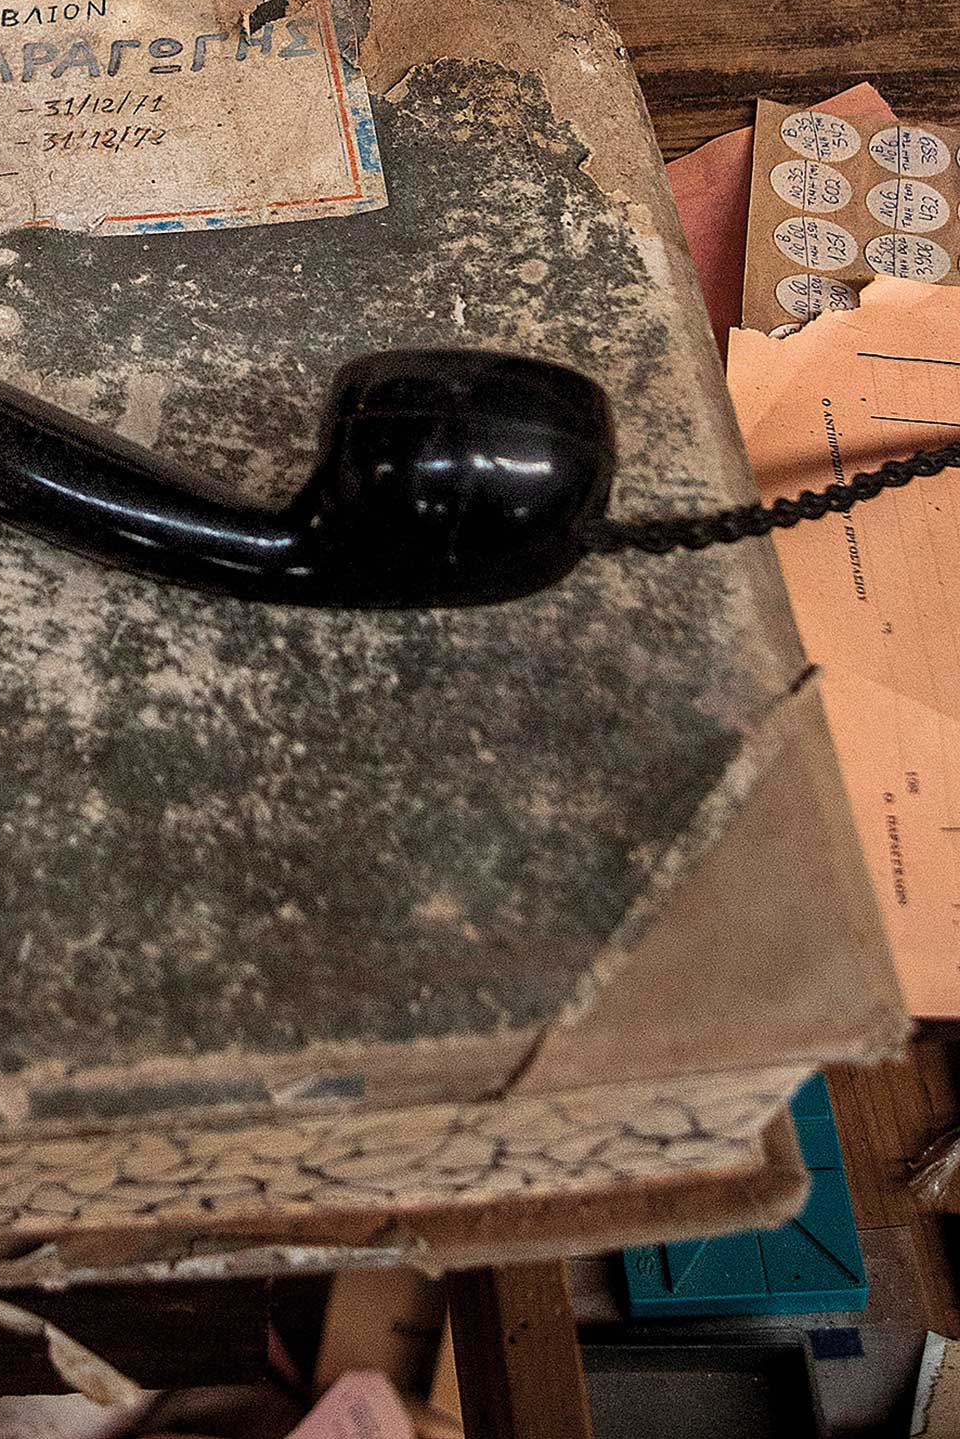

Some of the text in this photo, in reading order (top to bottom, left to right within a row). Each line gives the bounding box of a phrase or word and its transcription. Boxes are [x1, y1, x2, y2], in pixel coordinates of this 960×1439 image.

[830, 122, 848, 148] 542
[919, 136, 938, 164] 389
[821, 179, 841, 205] 602
[918, 195, 939, 222] 432
[824, 411, 846, 487] ΑΝΤΙΠΡΟΣΩΠΟ
